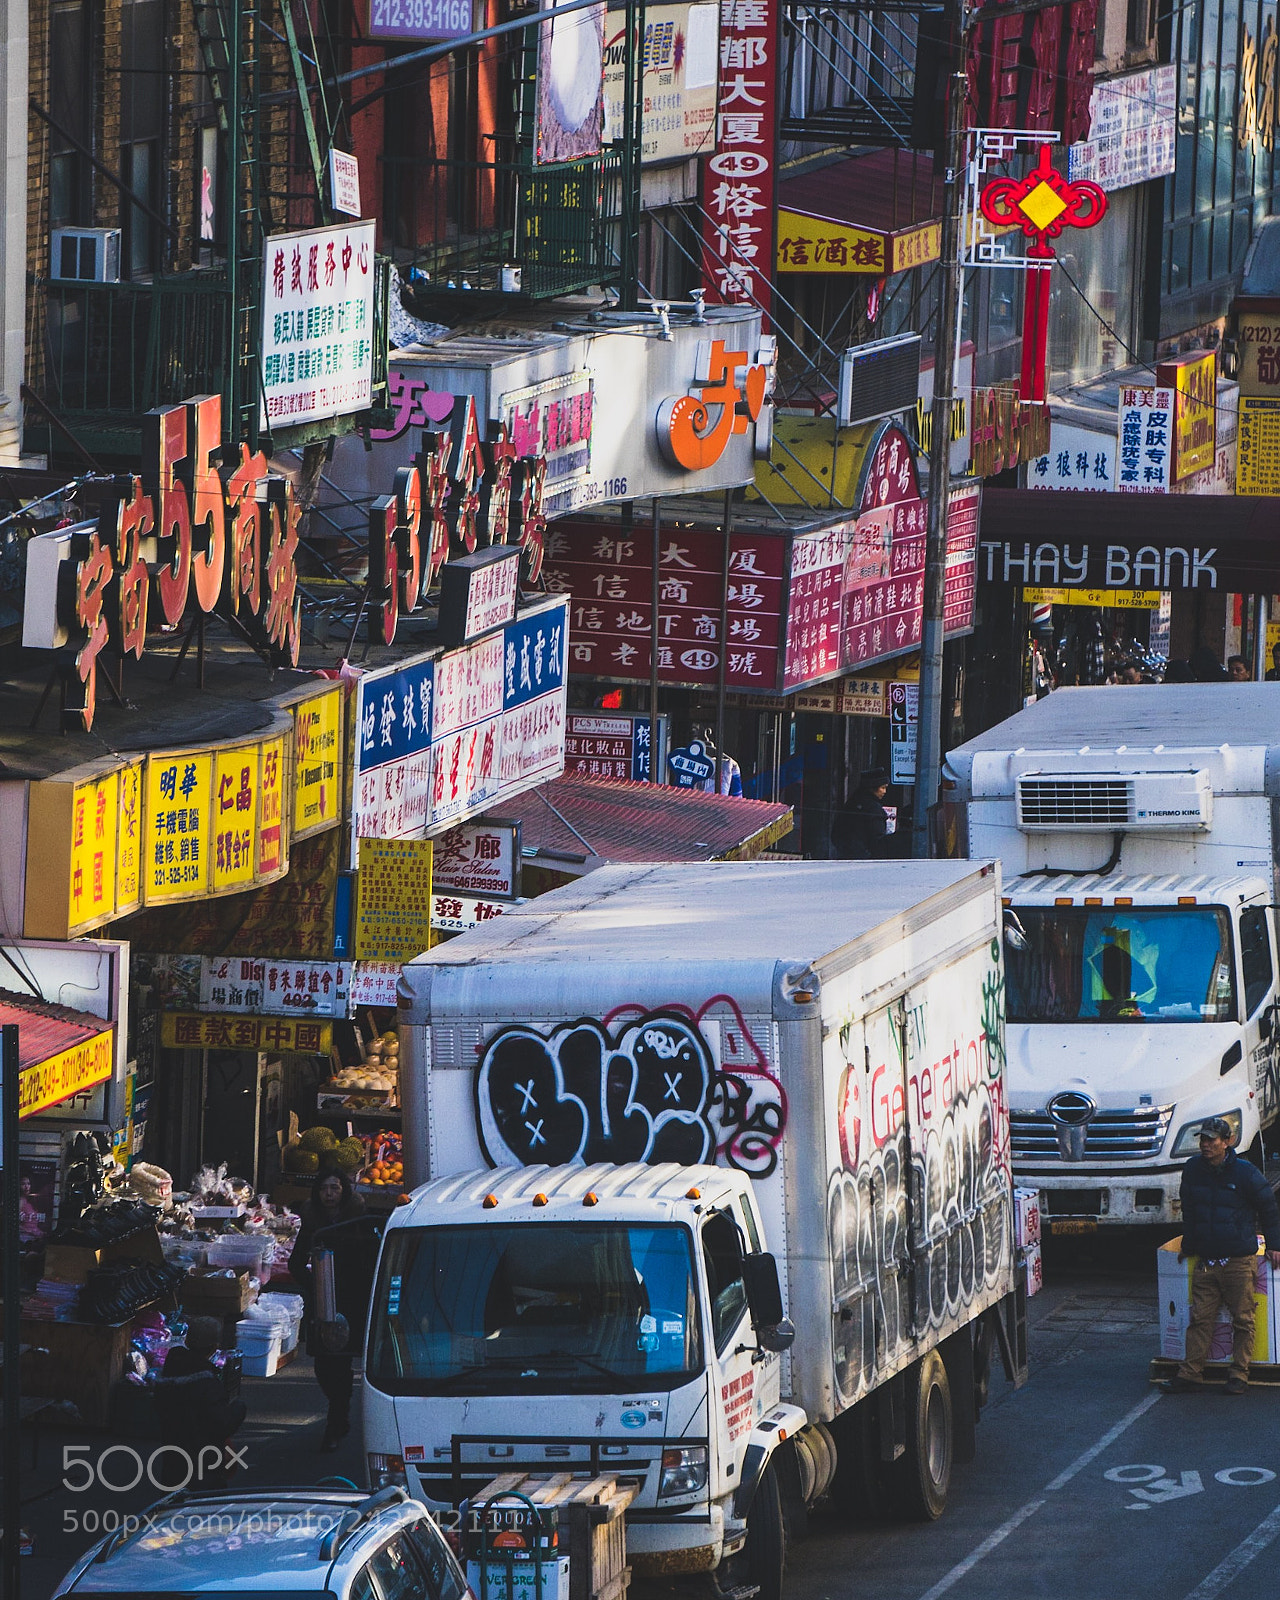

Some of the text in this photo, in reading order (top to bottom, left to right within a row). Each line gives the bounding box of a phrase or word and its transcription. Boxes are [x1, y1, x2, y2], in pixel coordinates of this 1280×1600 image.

[373, 0, 470, 31] 212-393-1166
[777, 237, 885, 267] 信酒樓
[1242, 326, 1272, 342] (212)
[1143, 411, 1169, 483] 皮肤专科
[981, 542, 1218, 589] THAY BANK
[160, 763, 198, 802] 明華
[263, 750, 278, 790] 55
[155, 808, 200, 836] 手機電腦
[1148, 808, 1201, 818] THERMO KING
[434, 824, 502, 863] 髮廊
[154, 865, 199, 886] 321-525-5134
[218, 963, 228, 979] &
[174, 1015, 322, 1051] 匯款到中國
[871, 1035, 989, 1148] Generation
